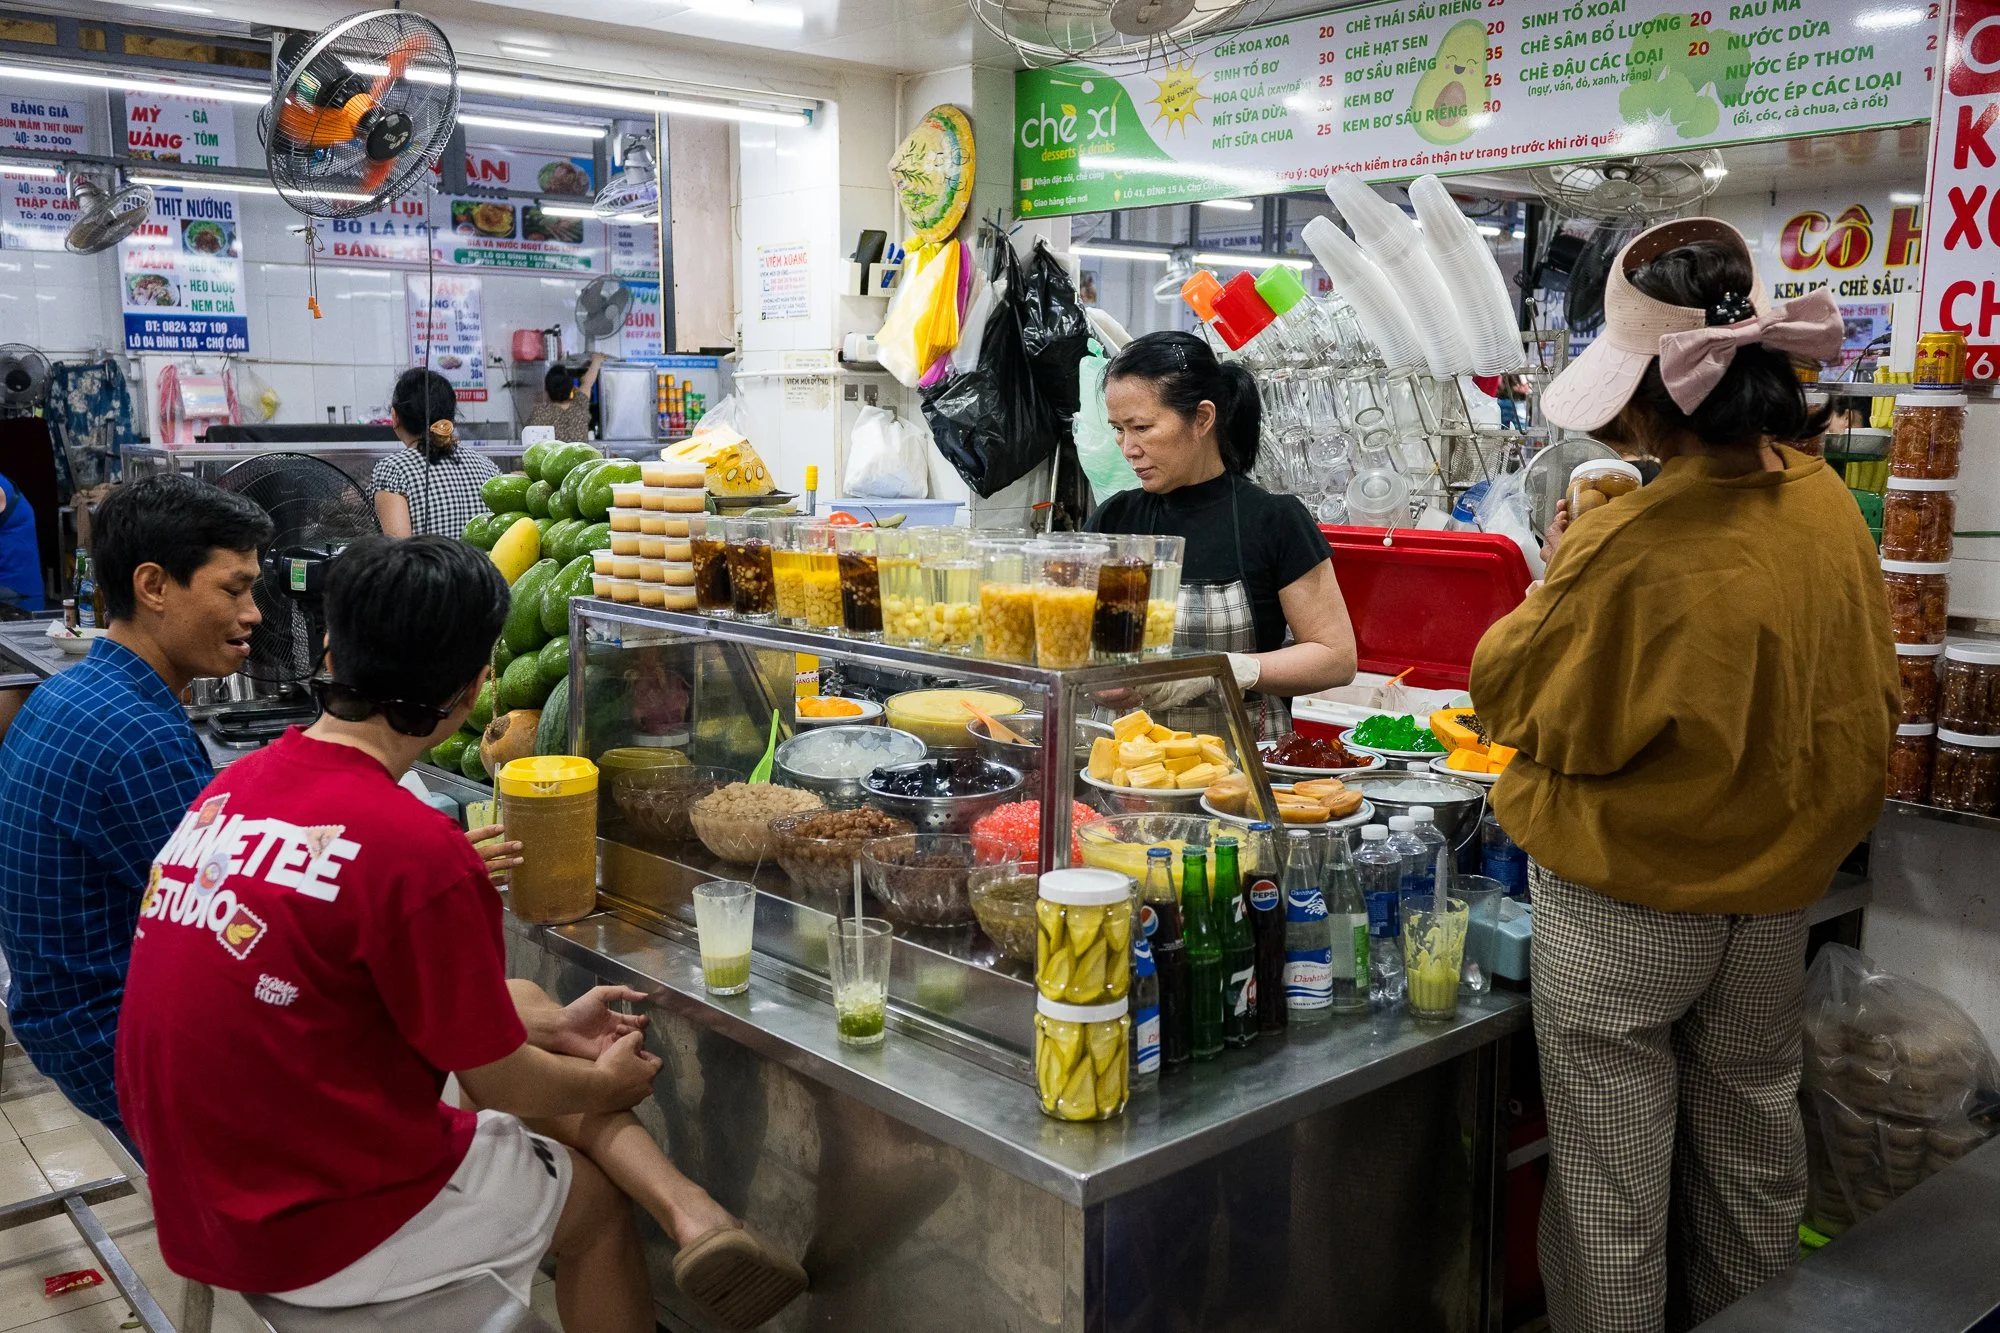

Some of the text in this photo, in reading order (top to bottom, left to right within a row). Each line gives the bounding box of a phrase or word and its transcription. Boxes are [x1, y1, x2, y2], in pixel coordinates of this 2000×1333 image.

[1346, 16, 1370, 34] CHÈ
[1374, 9, 1404, 28] THÁI
[1408, 2, 1435, 22] SẦU
[1690, 11, 1712, 27] 20
[1729, 1, 1767, 20] RAU
[1486, 21, 1504, 35] 20
[1522, 12, 1558, 29] SINH
[1319, 26, 1334, 38] 20
[1520, 16, 1681, 55] CHÈ SÂM BỔ LƯỢNG
[1728, 19, 1830, 50] NƯỚC DỪA
[1214, 34, 1290, 58] CHÈ XOA XOA
[1345, 35, 1428, 60] CHÈ HẠT SEN
[1486, 46, 1502, 61] 35
[1688, 41, 1709, 56] 20
[1319, 52, 1334, 64] 30
[1519, 48, 1663, 82] CHÈ ĐẬU CÁC LOẠI
[1726, 45, 1874, 80] NƯỚC ÉP THƠM
[1214, 58, 1279, 82] SINH TỐ BƠ
[1345, 57, 1436, 83] BƠ SẦU RIÊNG
[1319, 75, 1333, 87] 25
[1484, 73, 1502, 87] 25
[1213, 90, 1237, 104] HOA
[1240, 82, 1265, 101] QUẢ
[1344, 89, 1394, 108] KEM BƠ
[1724, 71, 1902, 108] NƯỚC ÉP CÁC LOẠI
[11, 100, 69, 118] BẢNG GIÁ
[1213, 104, 1288, 127] MÍT SỮA DỪA
[1483, 100, 1501, 113] 30
[1784, 104, 1799, 117] cà
[1802, 100, 1839, 116] chua,
[1843, 97, 1858, 111] cà
[192, 108, 208, 124] GÀ
[1343, 104, 1467, 133] KEM BƠ SẦU RIÊNG
[63, 124, 84, 134] QUAY
[128, 126, 182, 149] UẢNG
[194, 130, 218, 146] TÔM
[1317, 124, 1332, 135] 25
[34, 135, 72, 146] 30.000
[1212, 129, 1293, 149] MÍT SỮA CHUA
[1042, 148, 1076, 162] desserts
[1310, 165, 1329, 178] Quý
[1365, 157, 1390, 171] kiểm
[1392, 158, 1407, 168] tra
[1410, 151, 1429, 165] cẩn
[1432, 150, 1457, 165] thận
[1477, 146, 1507, 158] trang
[1511, 140, 1544, 155] trước
[1548, 137, 1566, 150] khi
[1570, 134, 1588, 147] rời
[155, 196, 183, 220] THỊT
[187, 196, 232, 219] NƯỚNG
[1779, 204, 1873, 272] CÔ
[190, 279, 208, 292] HEO
[1774, 282, 1804, 299] KEM
[1839, 275, 1868, 296] CHÈ
[1872, 270, 1904, 295] SẦU
[192, 296, 235, 313] NEM CHẢ
[162, 321, 187, 333] 0824
[189, 321, 206, 333] 337
[210, 322, 228, 334] 109
[129, 333, 140, 347] LÔ
[142, 336, 154, 348] 04
[156, 333, 178, 348] ĐÌNH
[181, 336, 198, 349] 15A
[206, 336, 223, 351] CHỢ
[1252, 889, 1277, 899] PEPSI
